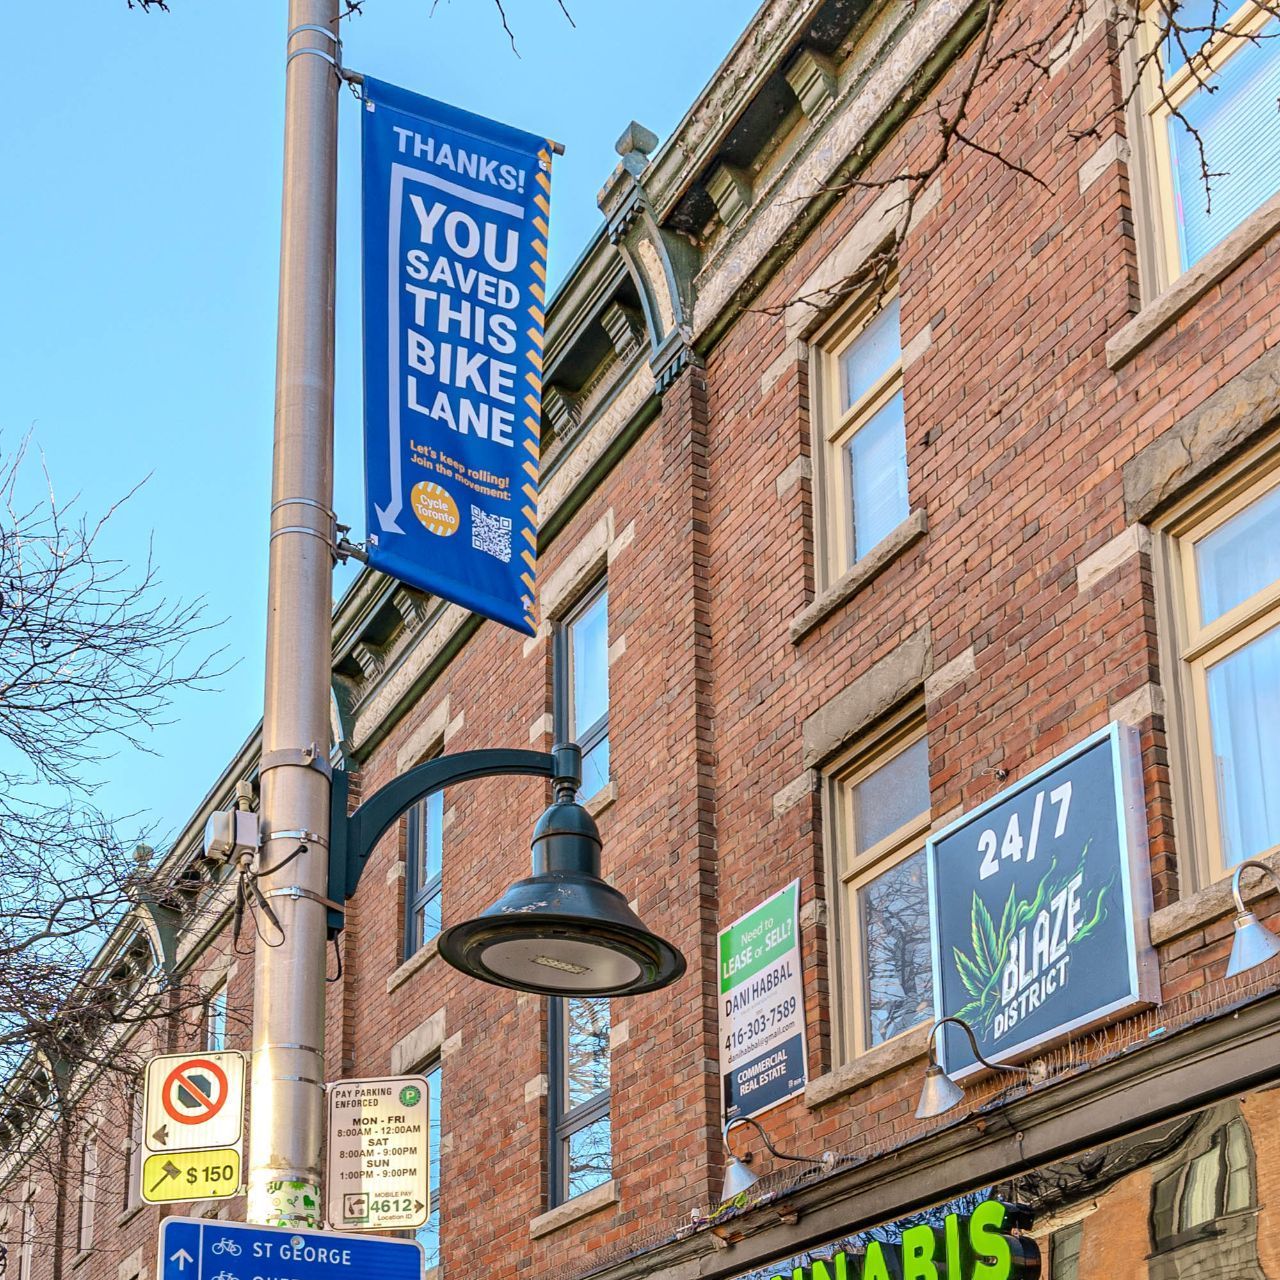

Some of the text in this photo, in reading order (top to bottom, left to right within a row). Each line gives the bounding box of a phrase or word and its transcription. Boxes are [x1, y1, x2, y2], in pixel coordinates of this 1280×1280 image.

[392, 124, 526, 194] THANKS!
[408, 193, 520, 273] YOU
[405, 248, 520, 310] SAVED
[404, 282, 518, 355] THIS
[406, 329, 518, 405] BIKE
[406, 375, 516, 448] LANE
[410, 439, 510, 489] Let's keep rolling!
[410, 453, 512, 501] Join the movement:
[415, 503, 456, 524] Toronto
[419, 494, 449, 512] Cycle
[976, 780, 1073, 881] 24/7
[723, 918, 793, 980] LEASE or SELL?
[740, 917, 774, 946] Need to
[999, 873, 1085, 1006] BLAZE
[725, 990, 751, 1018] DANI
[752, 961, 793, 1001] HABBAL
[993, 955, 1070, 1040] DISTRICT
[725, 996, 797, 1051] 416-303-7589
[727, 1020, 796, 1064] danihabbal@gmail.com
[737, 1049, 788, 1084] COMMERCIAL
[740, 1079, 759, 1097] REAL
[759, 1063, 787, 1086] ESTATE
[335, 1087, 393, 1099] PAY PARKING
[335, 1098, 379, 1109] ENFORCED
[406, 1090, 415, 1100] P
[337, 1128, 372, 1137] 8:00AM
[381, 1125, 421, 1135] 12:00AM
[352, 1117, 378, 1126] MON
[387, 1115, 406, 1124] FRI
[339, 1149, 375, 1159] 8:00AM
[383, 1147, 418, 1156] 9:00PM
[367, 1138, 389, 1147] SAT
[340, 1170, 374, 1180] 1:00PM
[382, 1168, 417, 1178] 9:00PM
[366, 1160, 390, 1168] SUN
[370, 1199, 413, 1213] 4612
[251, 1242, 352, 1266] ST GEORGE
